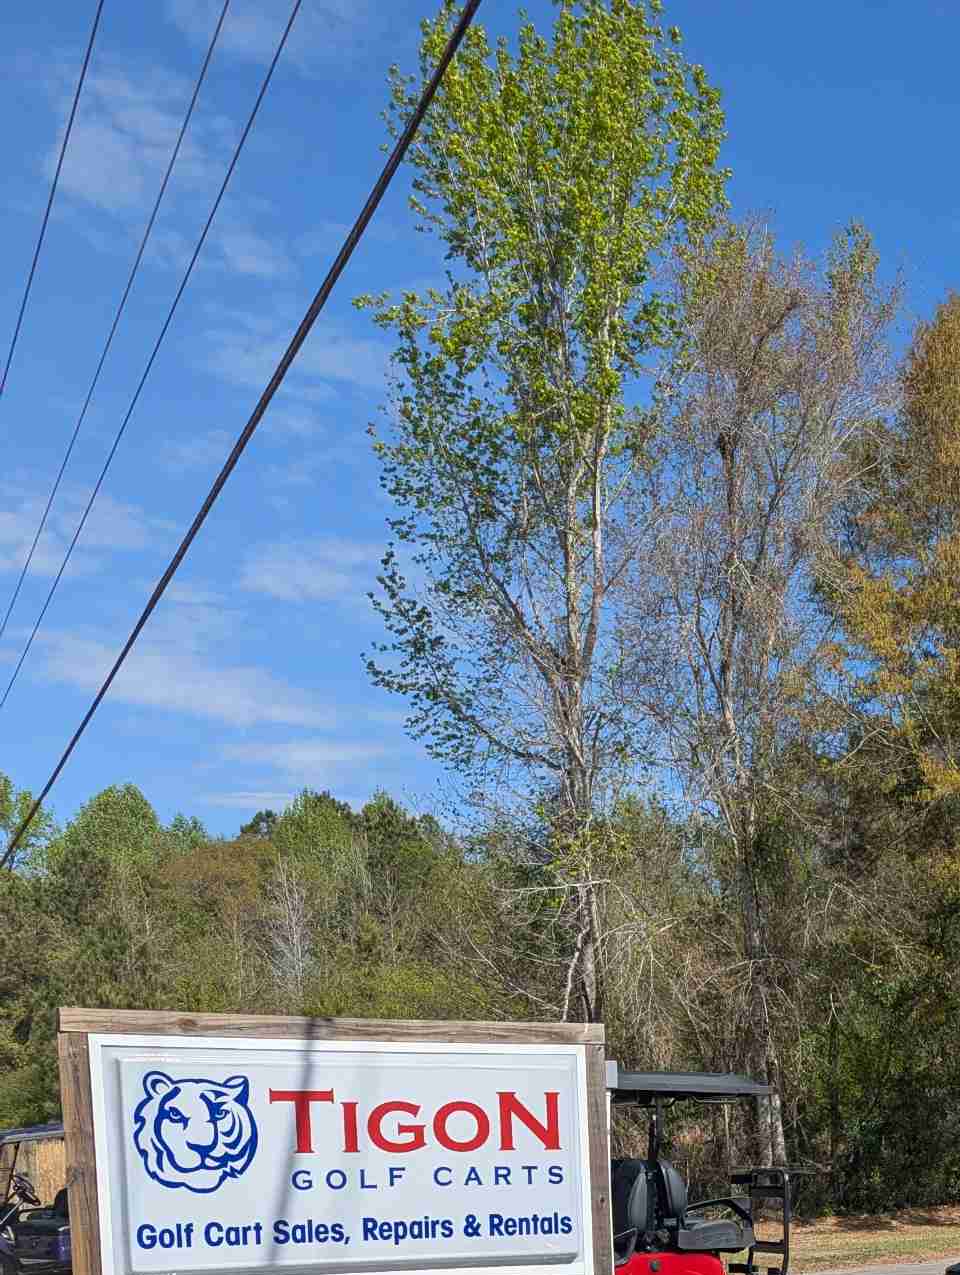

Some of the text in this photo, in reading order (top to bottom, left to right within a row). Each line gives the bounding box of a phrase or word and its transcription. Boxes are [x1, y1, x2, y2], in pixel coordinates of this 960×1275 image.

[270, 1088, 560, 1155] TIGON
[291, 1165, 565, 1190] GOLF CARTS
[136, 1212, 573, 1250] Golf Cart Sales, Repairs & Rentals
